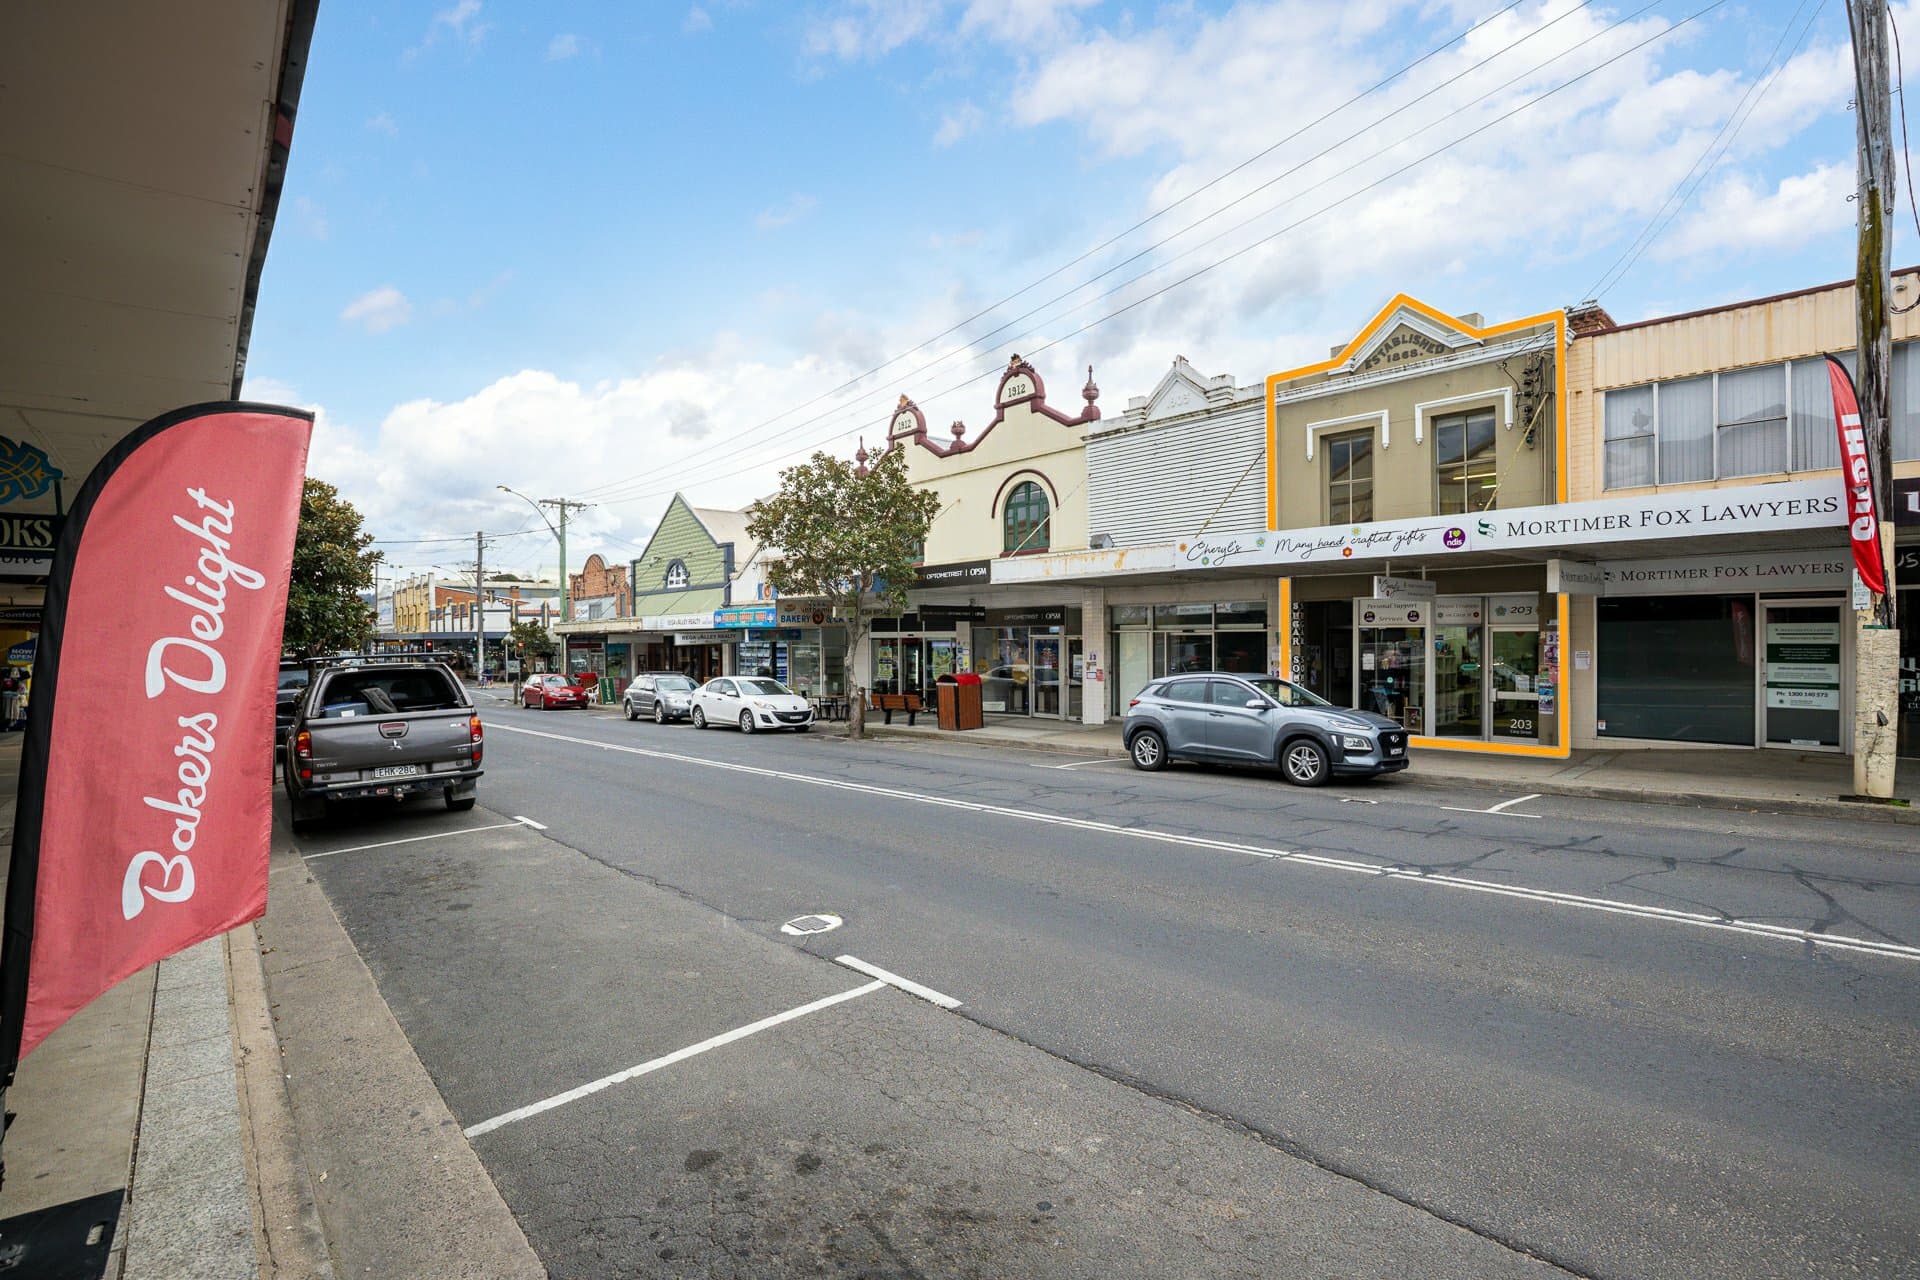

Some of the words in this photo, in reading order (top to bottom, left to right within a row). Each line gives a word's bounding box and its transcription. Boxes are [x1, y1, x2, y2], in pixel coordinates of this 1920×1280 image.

[1364, 333, 1445, 369] ESTABLISHED
[1008, 383, 1026, 398] 1912
[897, 419, 912, 431] 1912
[1507, 513, 1631, 537] MORTIMER
[1639, 509, 1693, 527] FOX
[1701, 496, 1838, 523] LAWYERS
[1187, 540, 1261, 566] Cheryl's
[1274, 538, 1313, 559] Many
[1317, 536, 1345, 549] hand
[1351, 531, 1392, 548] crafted
[1393, 527, 1427, 552] gifts
[926, 570, 963, 580] OPTOMETRIST
[970, 567, 987, 576] OPSM
[1620, 567, 1707, 582] MORTIMER
[1714, 565, 1749, 578] FOX
[1756, 562, 1844, 577] LAWYERS
[145, 486, 266, 699] Delight
[780, 615, 811, 623] BAKERY
[1510, 606, 1532, 615] 203
[1510, 718, 1532, 730] 203
[122, 712, 218, 921] Bakers
